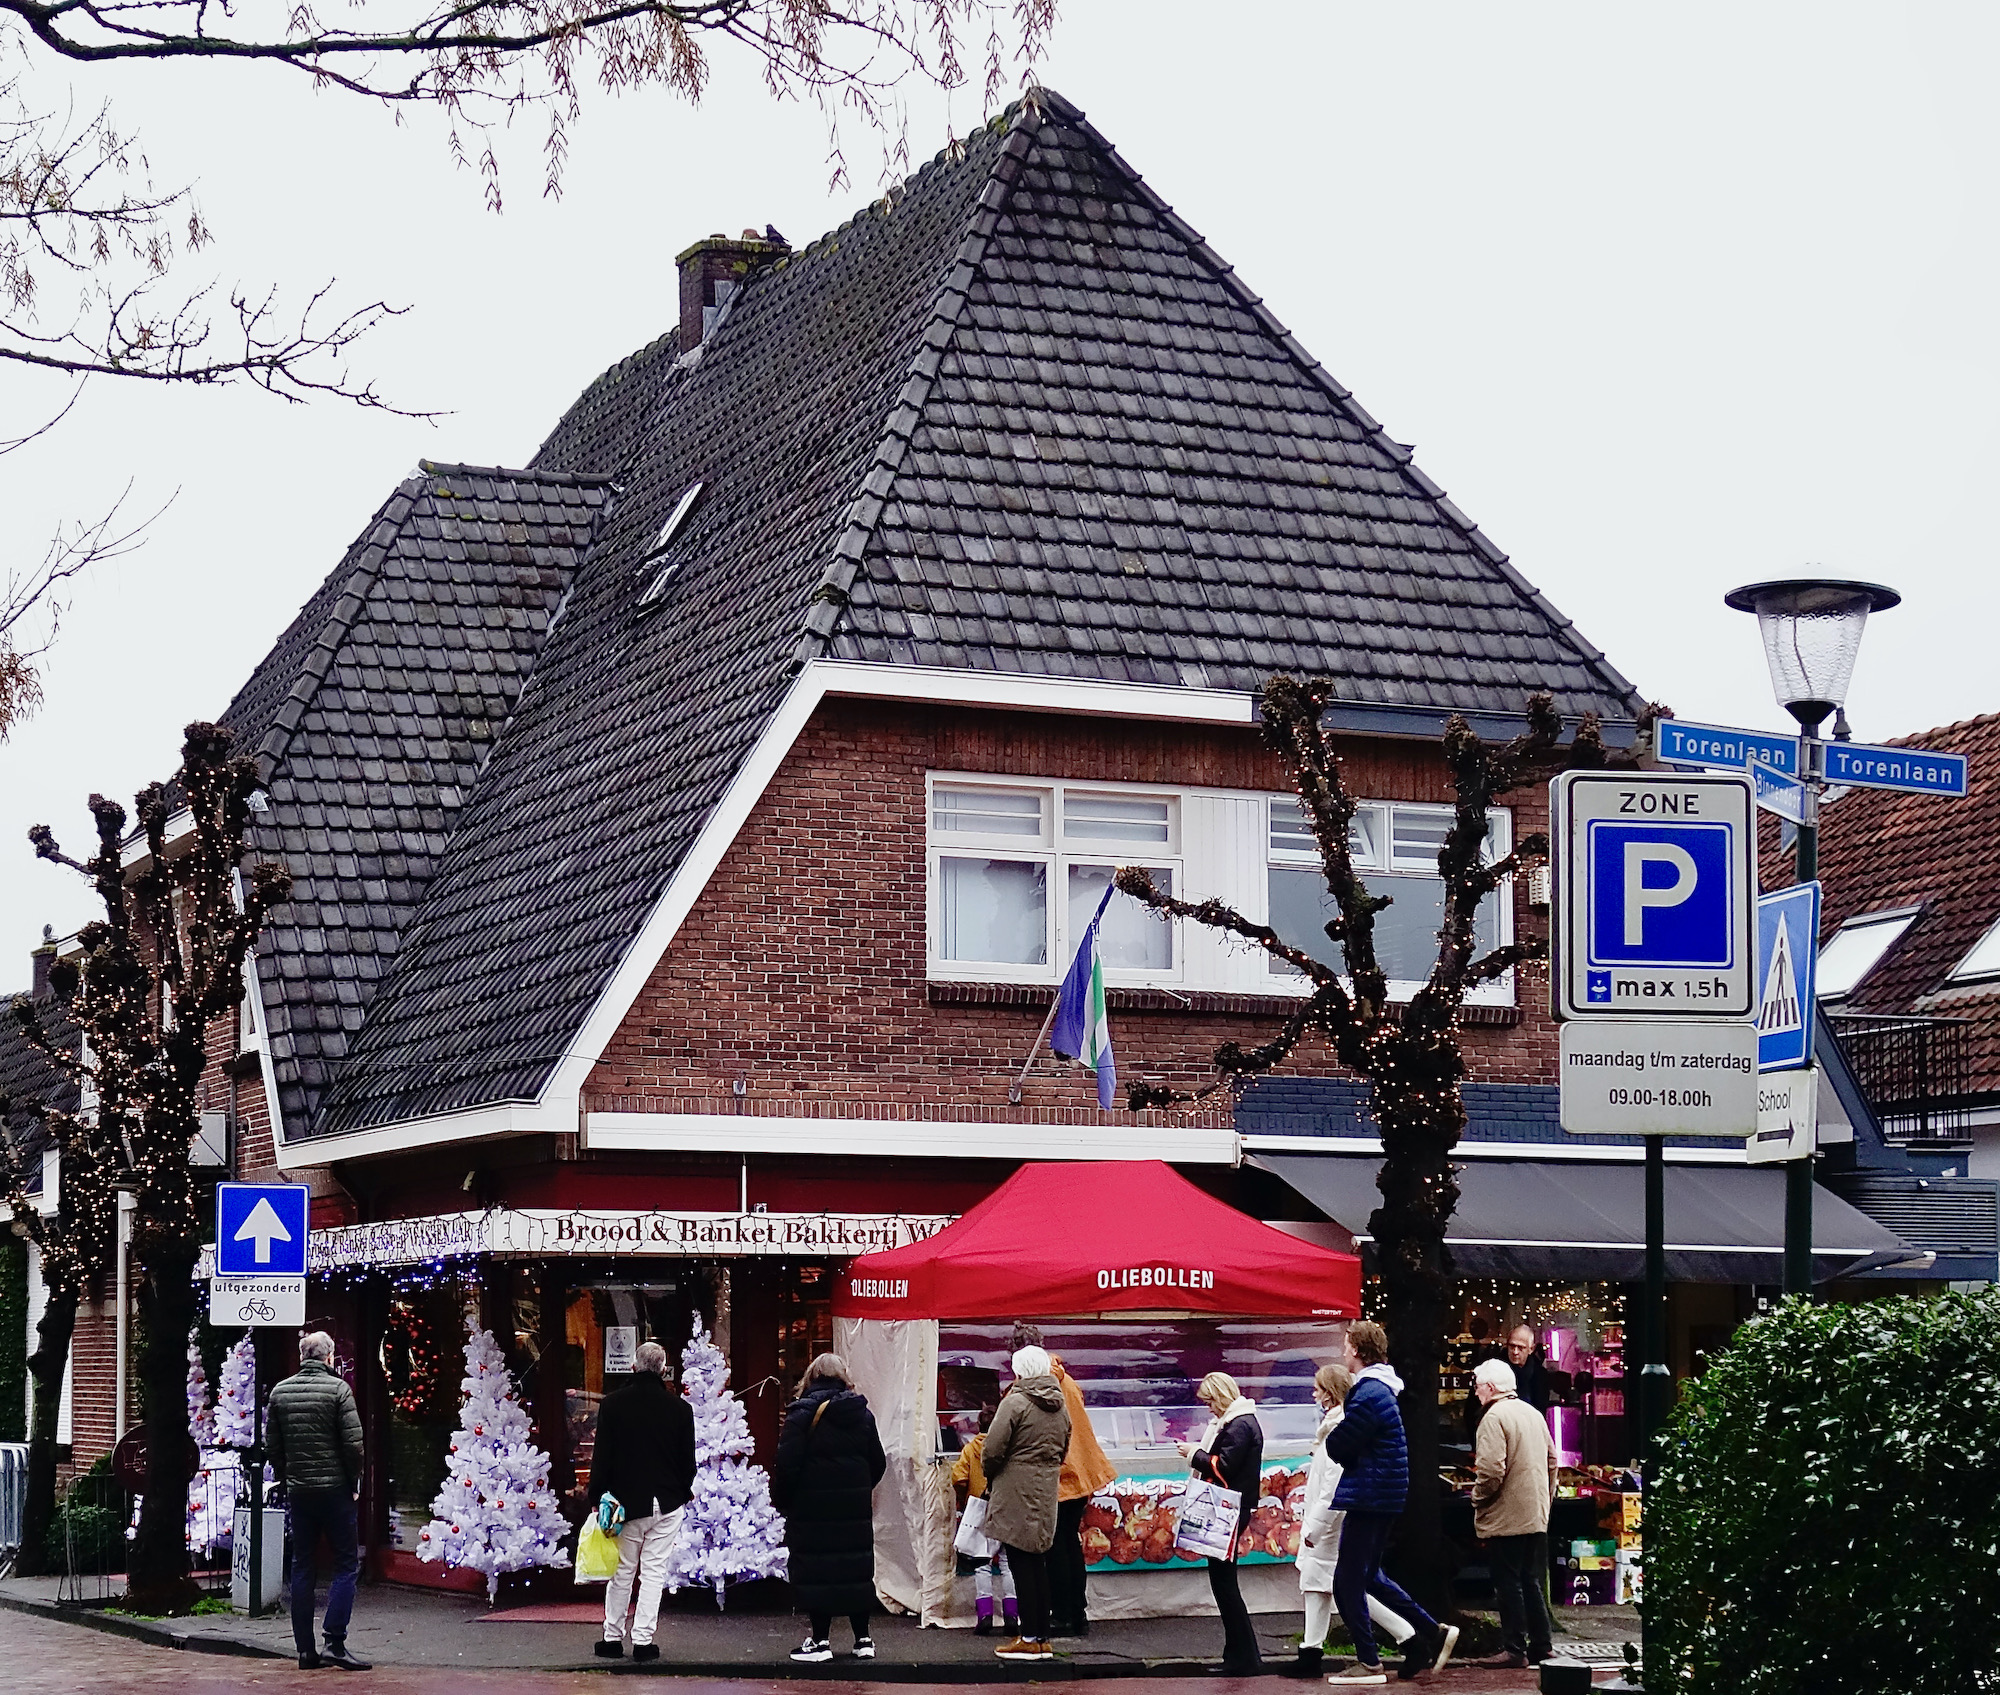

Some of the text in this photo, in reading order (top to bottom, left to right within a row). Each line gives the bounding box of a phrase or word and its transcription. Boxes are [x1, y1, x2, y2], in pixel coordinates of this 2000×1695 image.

[1671, 731, 1786, 766] Torenlaan
[1837, 753, 1953, 784] Torenlaan
[1619, 792, 1700, 815] ZONE
[1624, 841, 1698, 946] P
[1616, 977, 1729, 999] max 1,5h
[1569, 1050, 1752, 1073] maandag t/m zaterdag
[1609, 1088, 1712, 1107] 09.00-18.00h
[1758, 1087, 1792, 1112] School
[556, 1218, 642, 1242] Brood
[650, 1219, 671, 1242] &
[679, 1219, 779, 1244] Banket
[785, 1221, 898, 1251] Bakkerij
[215, 1282, 301, 1295] uitgezonderd
[851, 1278, 909, 1298] OLIEBOLLEN
[1097, 1266, 1214, 1289] OLIEBOLLEN
